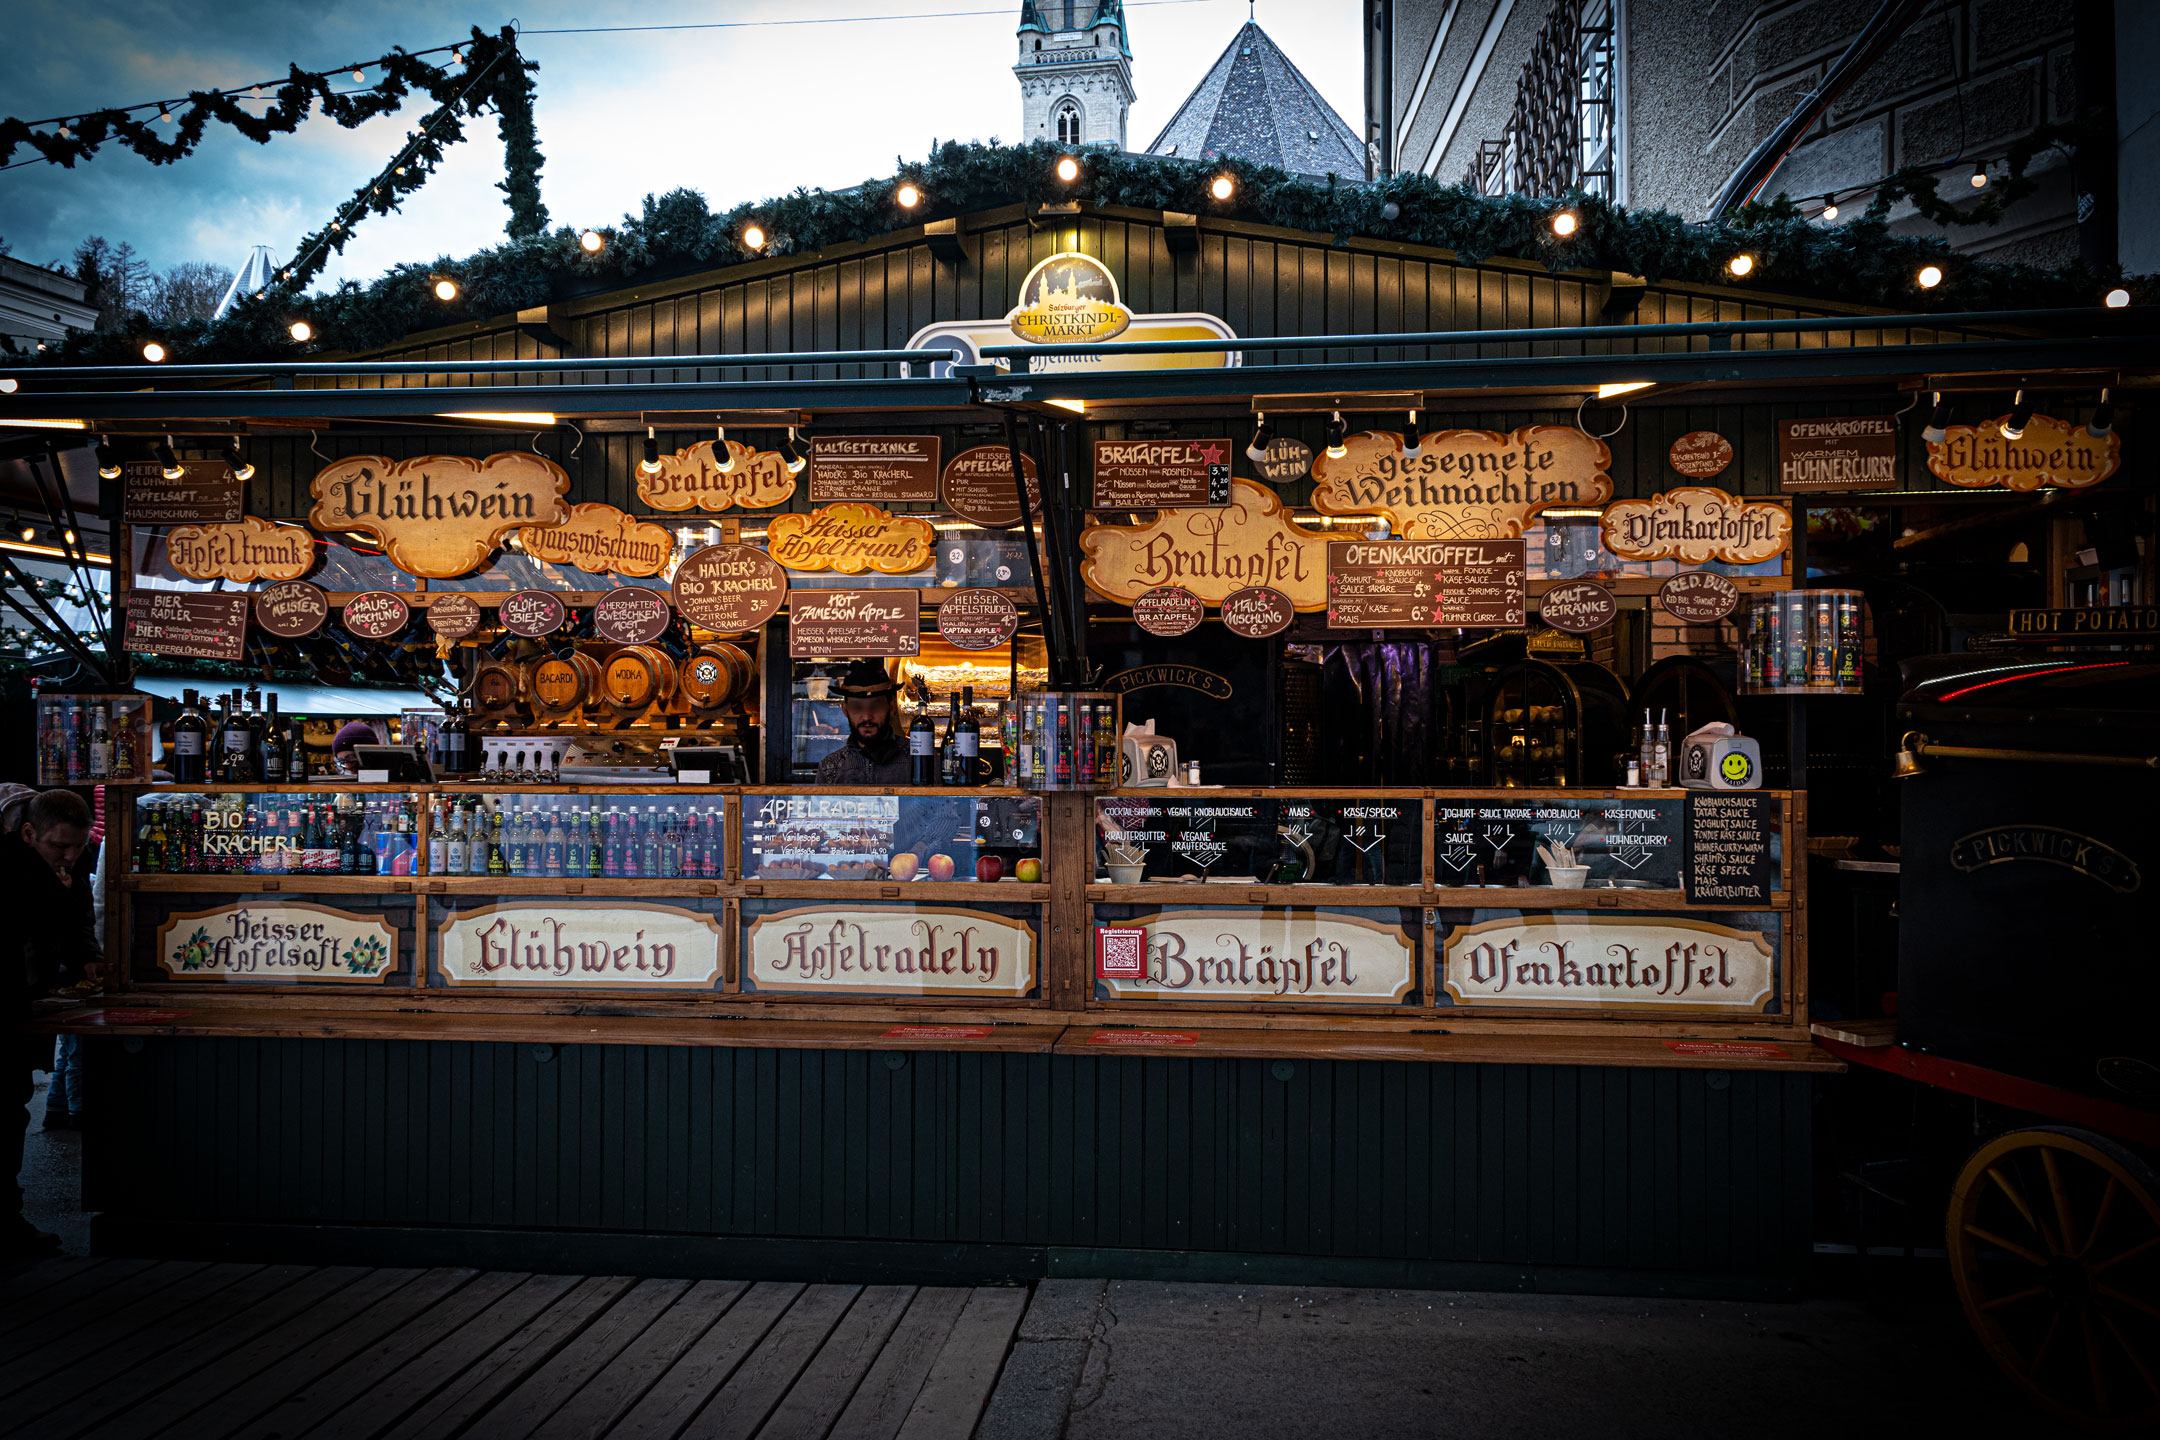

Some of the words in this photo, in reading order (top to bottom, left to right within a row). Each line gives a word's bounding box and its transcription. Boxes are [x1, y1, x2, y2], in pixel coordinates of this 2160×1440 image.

[1049, 303, 1087, 314] Salzburger
[1016, 312, 1122, 327] CHRISTKINDL-
[1043, 324, 1096, 337] MARKT
[1790, 419, 1894, 437] OFENKARTOFFEL
[816, 440, 920, 454] KALTGETRÄNKE
[1099, 443, 1203, 465] BRATAPFEL
[1941, 433, 2097, 473] Glühwein
[975, 452, 1012, 460] HEISSER
[1375, 441, 1555, 480] gesegnete
[1790, 449, 1859, 460] WARMEM
[873, 470, 914, 480] KRACHERL
[1119, 466, 1148, 476] NÜSSEN
[1161, 467, 1192, 477] ROSINEN
[1265, 460, 1307, 478] WEIN
[1783, 457, 1896, 481] HÜHNERCURRY
[650, 459, 787, 496] Bratapfel
[1146, 479, 1170, 489] Rosinen
[330, 467, 537, 522] Glühwein
[1335, 471, 1580, 507] Weihnachten
[132, 491, 198, 502] APFELSAFT
[1115, 499, 1157, 507] BAILEY'S
[128, 509, 200, 519] HAUSMISCHUNG
[801, 516, 889, 538] Heisser
[1624, 502, 1776, 548] Ofenkartoffel
[175, 530, 304, 573] Apfeltrunk
[531, 527, 661, 566] Hausmischung
[776, 535, 918, 561] Apfeltrunk
[1127, 508, 1309, 592] Bratapfel
[1346, 543, 1494, 566] OFENKARTOFFEL
[699, 558, 756, 578] HAIDER'S
[1384, 569, 1424, 577] KNOBLAUCH-
[680, 583, 705, 595] BIO
[711, 577, 777, 595] KRACHERL
[1443, 575, 1489, 585] KÄSE-SAUCE
[1666, 574, 1700, 594] RED
[1703, 574, 1736, 599] BULL
[263, 585, 312, 608] JÄGER-
[1339, 585, 1365, 594] SAUCE
[1549, 584, 1599, 604] KALT-
[154, 595, 182, 609] BIER
[354, 600, 394, 613] HAUS-
[606, 601, 656, 610] HERZHAFTER
[828, 594, 861, 608] HOT
[955, 595, 999, 605] HEISSER
[1137, 598, 1191, 607] APFELRADELN
[1233, 599, 1274, 613] HAUS-
[1442, 596, 1471, 605] SAUCE
[150, 607, 192, 622] RADLER
[271, 598, 324, 618] MEISTER
[792, 605, 856, 625] JAMESON
[858, 603, 906, 623] APPLE
[942, 604, 1015, 614] APFELSTRUDEL
[1542, 599, 1610, 618] GETRÄNKE
[351, 609, 400, 625] MISCHUNG
[510, 611, 551, 624] BIER
[700, 612, 738, 621] ZITRONE
[715, 619, 748, 628] ORANGE
[1139, 613, 1195, 621] BRATAPFEL
[1224, 608, 1283, 626] MISCHUNG
[1338, 615, 1359, 624] MAIS
[1442, 612, 1472, 622] HÜHNER
[1472, 611, 1497, 622] CURRY
[2020, 611, 2062, 632] HOT
[2074, 608, 2159, 631] POTATO
[135, 625, 163, 639] BIER
[611, 620, 641, 631] MOST
[797, 627, 825, 635] HEISSER
[827, 626, 862, 635] APFELSAFT
[793, 636, 825, 646] JAMESON
[810, 646, 832, 654] MONIN
[540, 672, 573, 684] BACARDI
[615, 669, 643, 680] WODKA
[1119, 667, 1213, 691] PICKWICK'S
[760, 799, 899, 819] APFELRADELN
[1167, 807, 1191, 817] VEGANE
[1194, 807, 1254, 818] KNOBLAUCHSAUCE
[1288, 807, 1311, 818] MAIS
[1343, 806, 1398, 819] KÄSE/SPECK
[1479, 808, 1502, 819] SAUCE
[1502, 808, 1532, 819] TARTARE
[1536, 809, 1580, 820] KNOBLAUCH
[1604, 808, 1657, 820] KÄSEFONDUE
[1693, 807, 1719, 818] TATAR
[1719, 808, 1750, 819] SAUCE
[1693, 819, 1730, 830] JOGHURT
[1729, 819, 1758, 830] SAUCE
[1104, 829, 1166, 841] KRÄUTERBUTTER
[1181, 831, 1211, 842] VEGANE
[1445, 833, 1474, 844] SAUCE
[1605, 834, 1668, 846] HÜHNERCURRY
[1693, 829, 1720, 841] FONDUE
[1719, 829, 1737, 841] KÄSE
[1737, 830, 1762, 842] SAUCE
[203, 834, 305, 854] KRACHERL
[1172, 840, 1227, 852] KRÄUTERSAUCE
[1728, 854, 1756, 865] SAUCE
[1694, 863, 1717, 876] KÄSE
[1719, 865, 1752, 877] SPECK
[1694, 885, 1762, 899] KRÄUTERBUTTER
[226, 908, 325, 943] Heisser
[1100, 928, 1143, 936] Registrierung
[206, 935, 343, 972] Apfelsaft
[470, 916, 677, 978] Glühwein
[771, 918, 1000, 983] Apfelradeln
[1144, 931, 1358, 996] Bratäpfel
[1464, 938, 1735, 996] Ofenkartoffel
